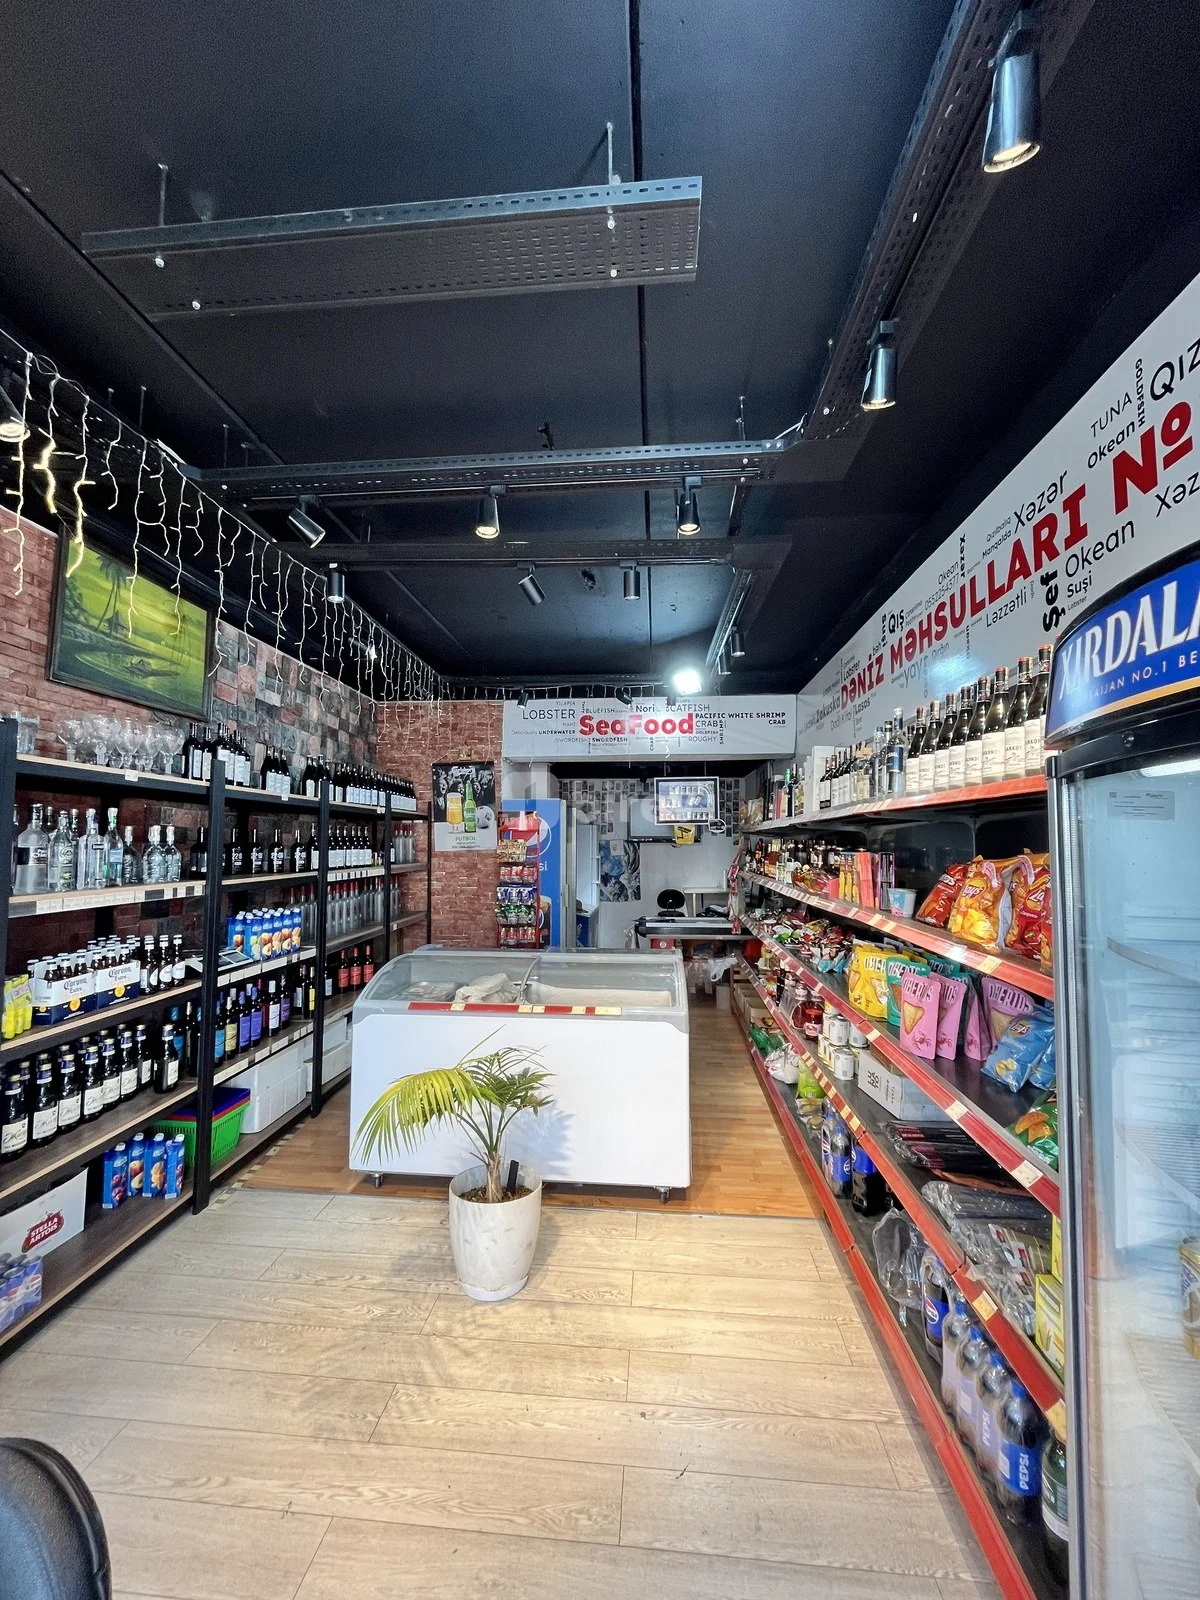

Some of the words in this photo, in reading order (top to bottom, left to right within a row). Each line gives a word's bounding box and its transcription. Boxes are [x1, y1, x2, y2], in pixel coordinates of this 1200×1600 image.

[1090, 391, 1133, 438] TUNA
[1087, 421, 1135, 469] Okean
[1013, 470, 1068, 534] Xəzər
[1065, 519, 1136, 578] Okean
[890, 482, 1089, 676] MƏHSULLARI
[938, 561, 959, 585] Okean
[1066, 570, 1093, 599] Suşi
[986, 586, 1028, 628] Ləzzətli
[1059, 580, 1200, 701] XIRDAL
[522, 709, 576, 720] LOBSTER
[635, 704, 656, 713] Nori
[670, 703, 710, 712] CATFISH
[579, 712, 694, 736] SeaFood
[695, 720, 719, 728] CRAB
[29, 1223, 58, 1246] ARTOIS
[30, 1217, 58, 1237] STELLA
[1018, 1453, 1030, 1491] PEPSI
